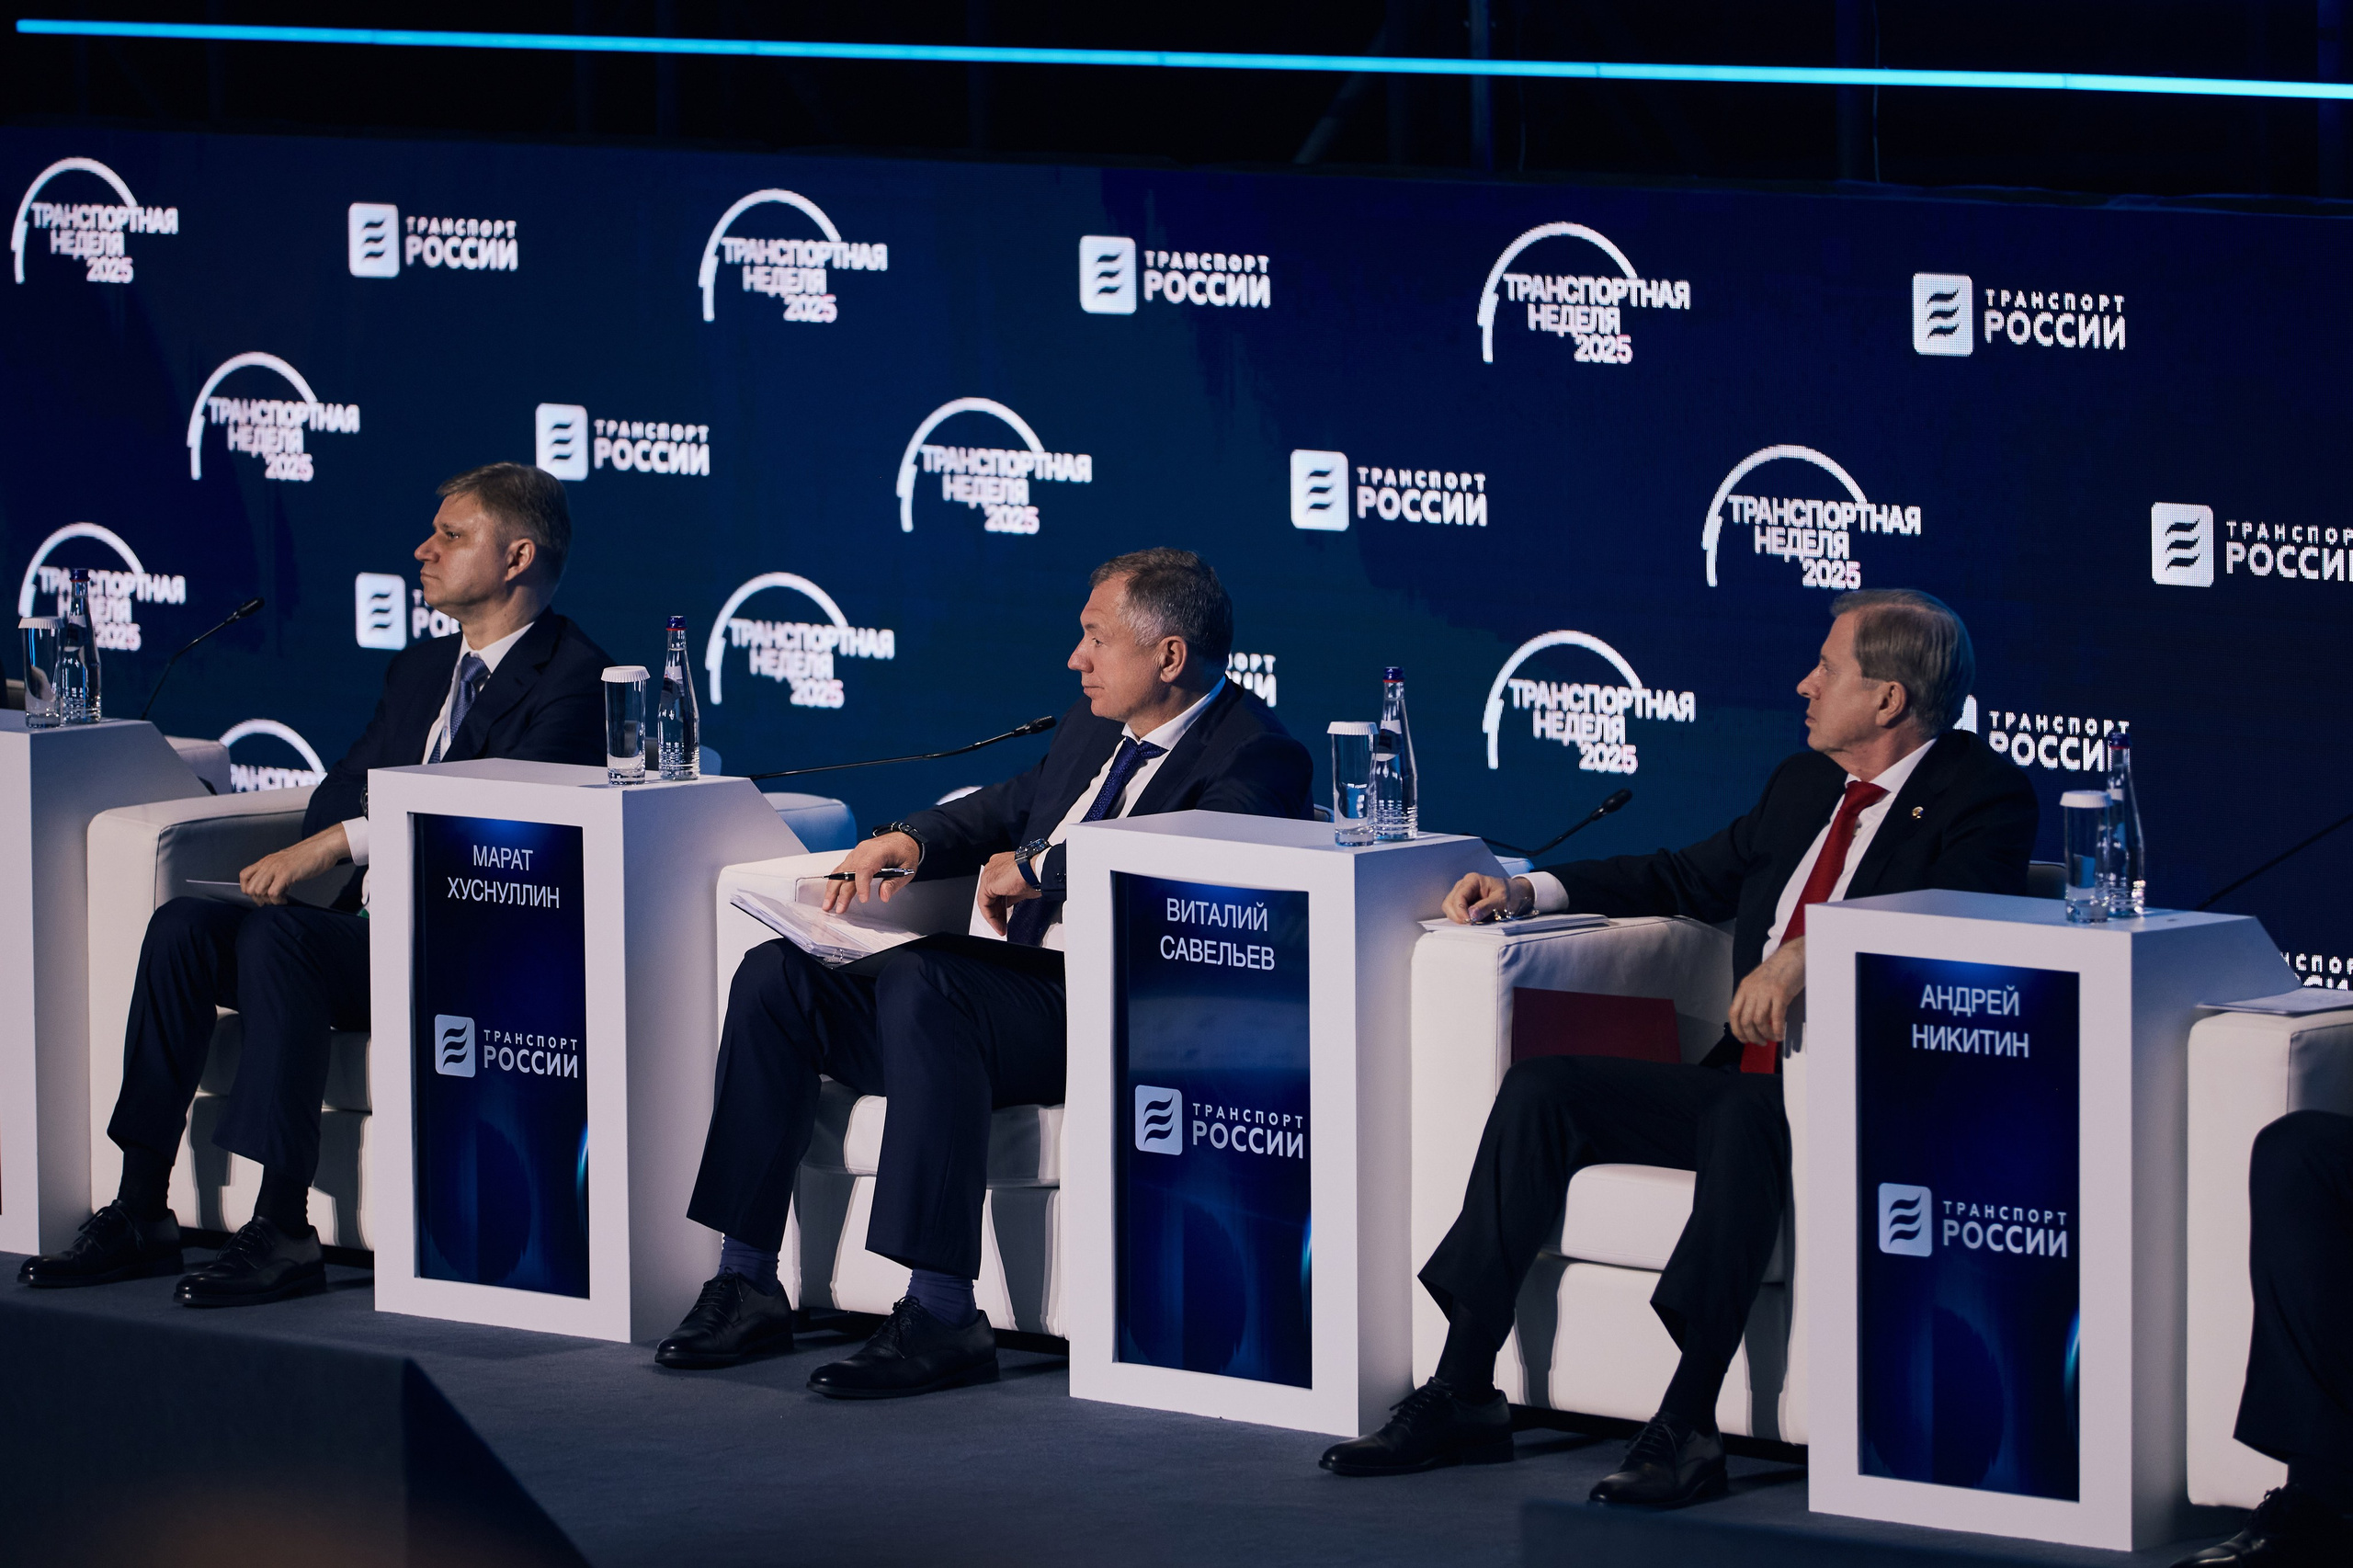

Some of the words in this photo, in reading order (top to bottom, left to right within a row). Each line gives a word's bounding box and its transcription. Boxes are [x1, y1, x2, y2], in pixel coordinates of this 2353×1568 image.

[31, 202, 178, 234] ТРАНСПОРТНАЯ
[406, 217, 517, 238] ТРАНСПОРТ
[51, 230, 125, 260] НЕДЕЛЯ
[405, 235, 518, 270] РОССИИ
[722, 237, 888, 270] ТРАНСПОРТНАЯ
[86, 257, 133, 283] 2025
[1144, 250, 1269, 274] ТРАНСПОРТ
[743, 266, 827, 297] НЕДЕЛЯ
[1144, 270, 1270, 308] РОССИИ
[1504, 274, 1691, 311] ТРАНСПОРТНАЯ
[783, 295, 837, 323] 2025
[1984, 289, 2125, 313] ТРАНСПОРТ
[1527, 304, 1620, 337] НЕДЕЛЯ
[1984, 309, 2126, 350] РОССИИ
[1574, 335, 1632, 364] 2025
[209, 397, 359, 433] ТРАНСПОРТНАЯ
[594, 419, 710, 443] ТРАНСПОРТ
[228, 426, 303, 458] НЕДЕЛЯ
[594, 439, 710, 475] РОССИИ
[266, 453, 313, 482] 2025
[920, 445, 1092, 483] ТРАНСПОРТНАЯ
[1357, 467, 1486, 493] ТРАНСПОРТ
[943, 477, 1029, 509] НЕДЕЛЯ
[1357, 486, 1487, 526] РОССИИ
[984, 506, 1040, 534] 2025
[1728, 494, 1921, 535] ТРАНСПОРТНАЯ
[1755, 526, 1849, 562] НЕДЕЛЯ
[2226, 520, 2353, 546] ТРАНСПОР
[1802, 559, 1861, 589] 2025
[2226, 541, 2353, 582] РОССИ
[38, 566, 186, 605] ТРАСПОРТНАЯ
[728, 618, 895, 659] ТРАНСПОРТНАЯ
[749, 649, 835, 684] НЕДЕЛЯ
[790, 678, 844, 708] 2025
[1508, 678, 1696, 722] ТРАНСПОРТНАЯ
[1533, 710, 1625, 746] НЕДЕЛЯ
[1989, 710, 2130, 736] ТРАНСПОРТ
[1578, 741, 1637, 773] 2025
[472, 845, 533, 871] МАРАТ
[447, 877, 560, 909] ХУСНУЛЛИН
[1166, 898, 1267, 932] ВИТАЛИЙ
[1160, 935, 1275, 971] САВЕЛЬЕВ
[1920, 984, 2019, 1017] АНДРЕЙ
[483, 1029, 577, 1051] ТРАНСПОРТ
[1912, 1023, 2029, 1058] НИКИТИН
[483, 1045, 578, 1078] РОССИИ
[1192, 1103, 1303, 1129] ТРАНСПОРТ
[1192, 1119, 1303, 1159] РОССИИ
[1943, 1200, 2067, 1225] ТРАНСПОРТ
[1943, 1219, 2067, 1258] РОССИИ
